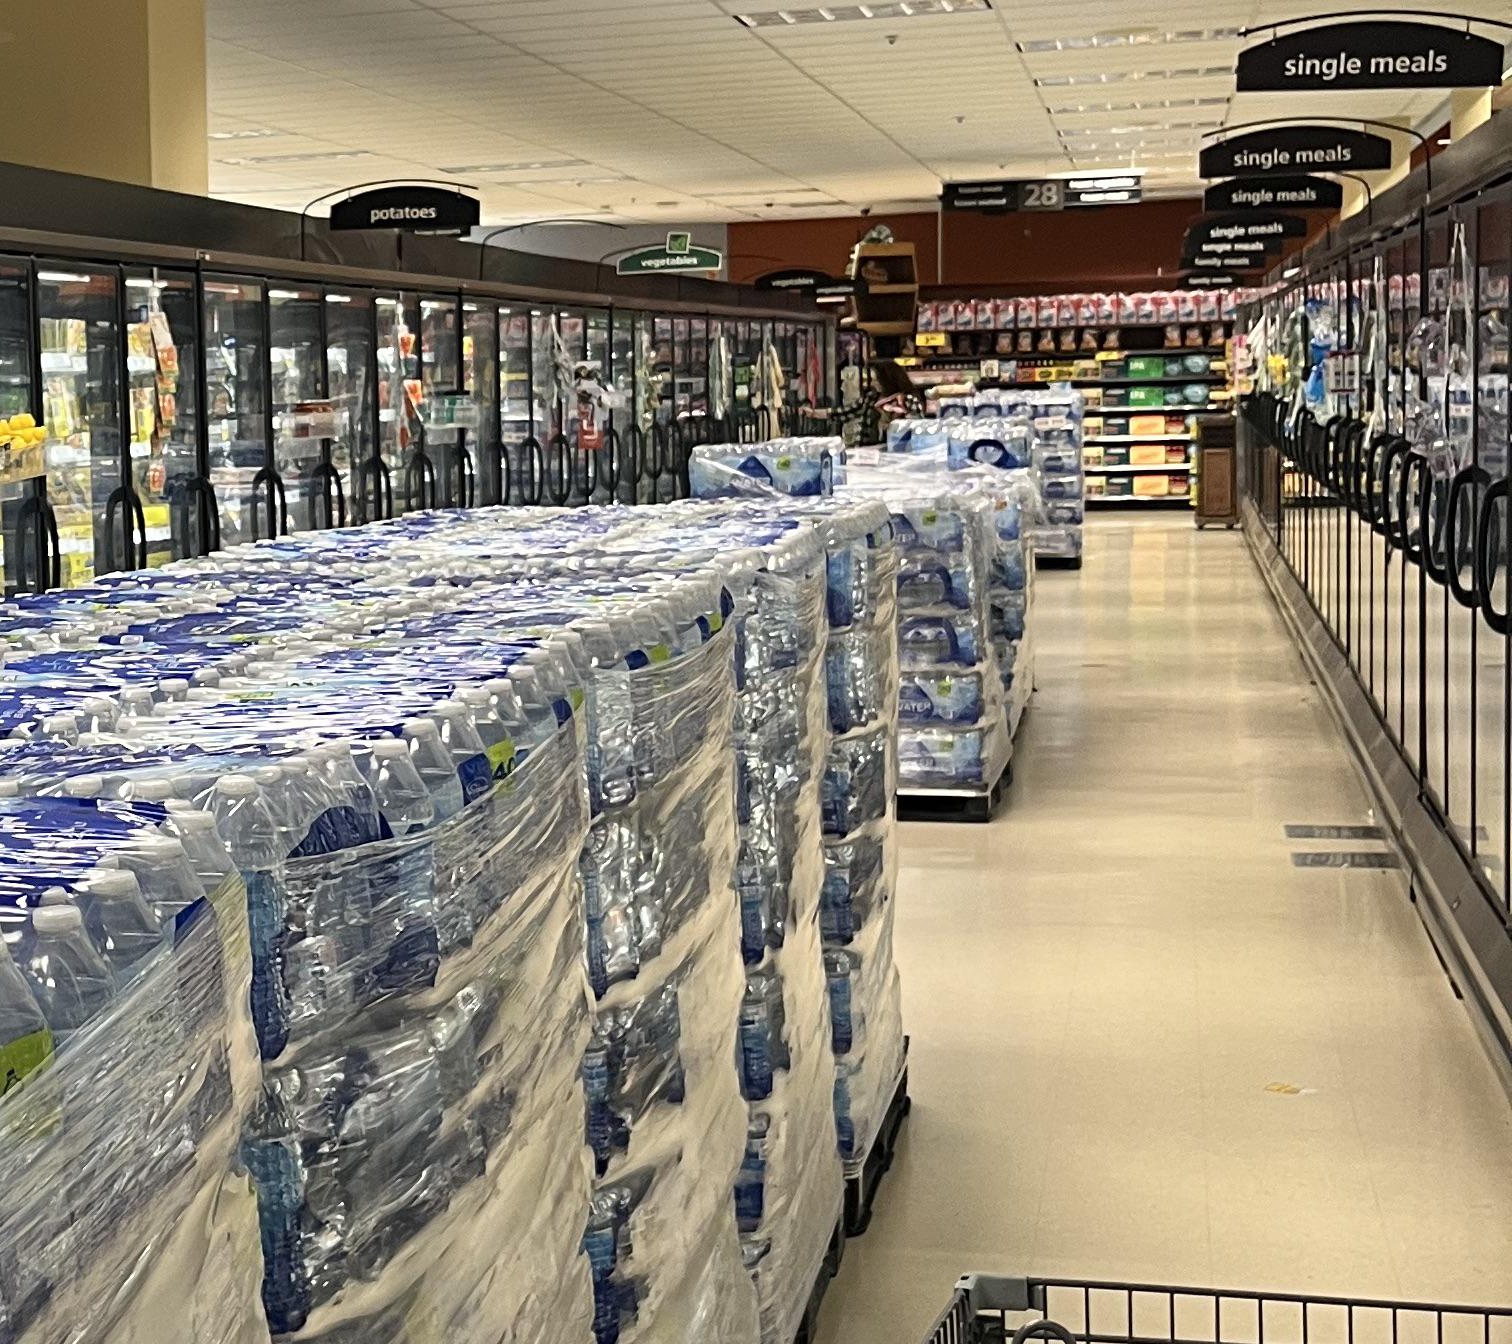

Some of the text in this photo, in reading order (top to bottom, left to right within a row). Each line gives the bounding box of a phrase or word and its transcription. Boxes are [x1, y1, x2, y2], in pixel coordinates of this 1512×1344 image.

[1284, 49, 1448, 82] single meals
[1233, 144, 1352, 169] single meals
[1023, 182, 1059, 207] 28
[1231, 187, 1317, 206] single meals
[369, 202, 437, 224] potatoes
[640, 255, 698, 268] vegetables
